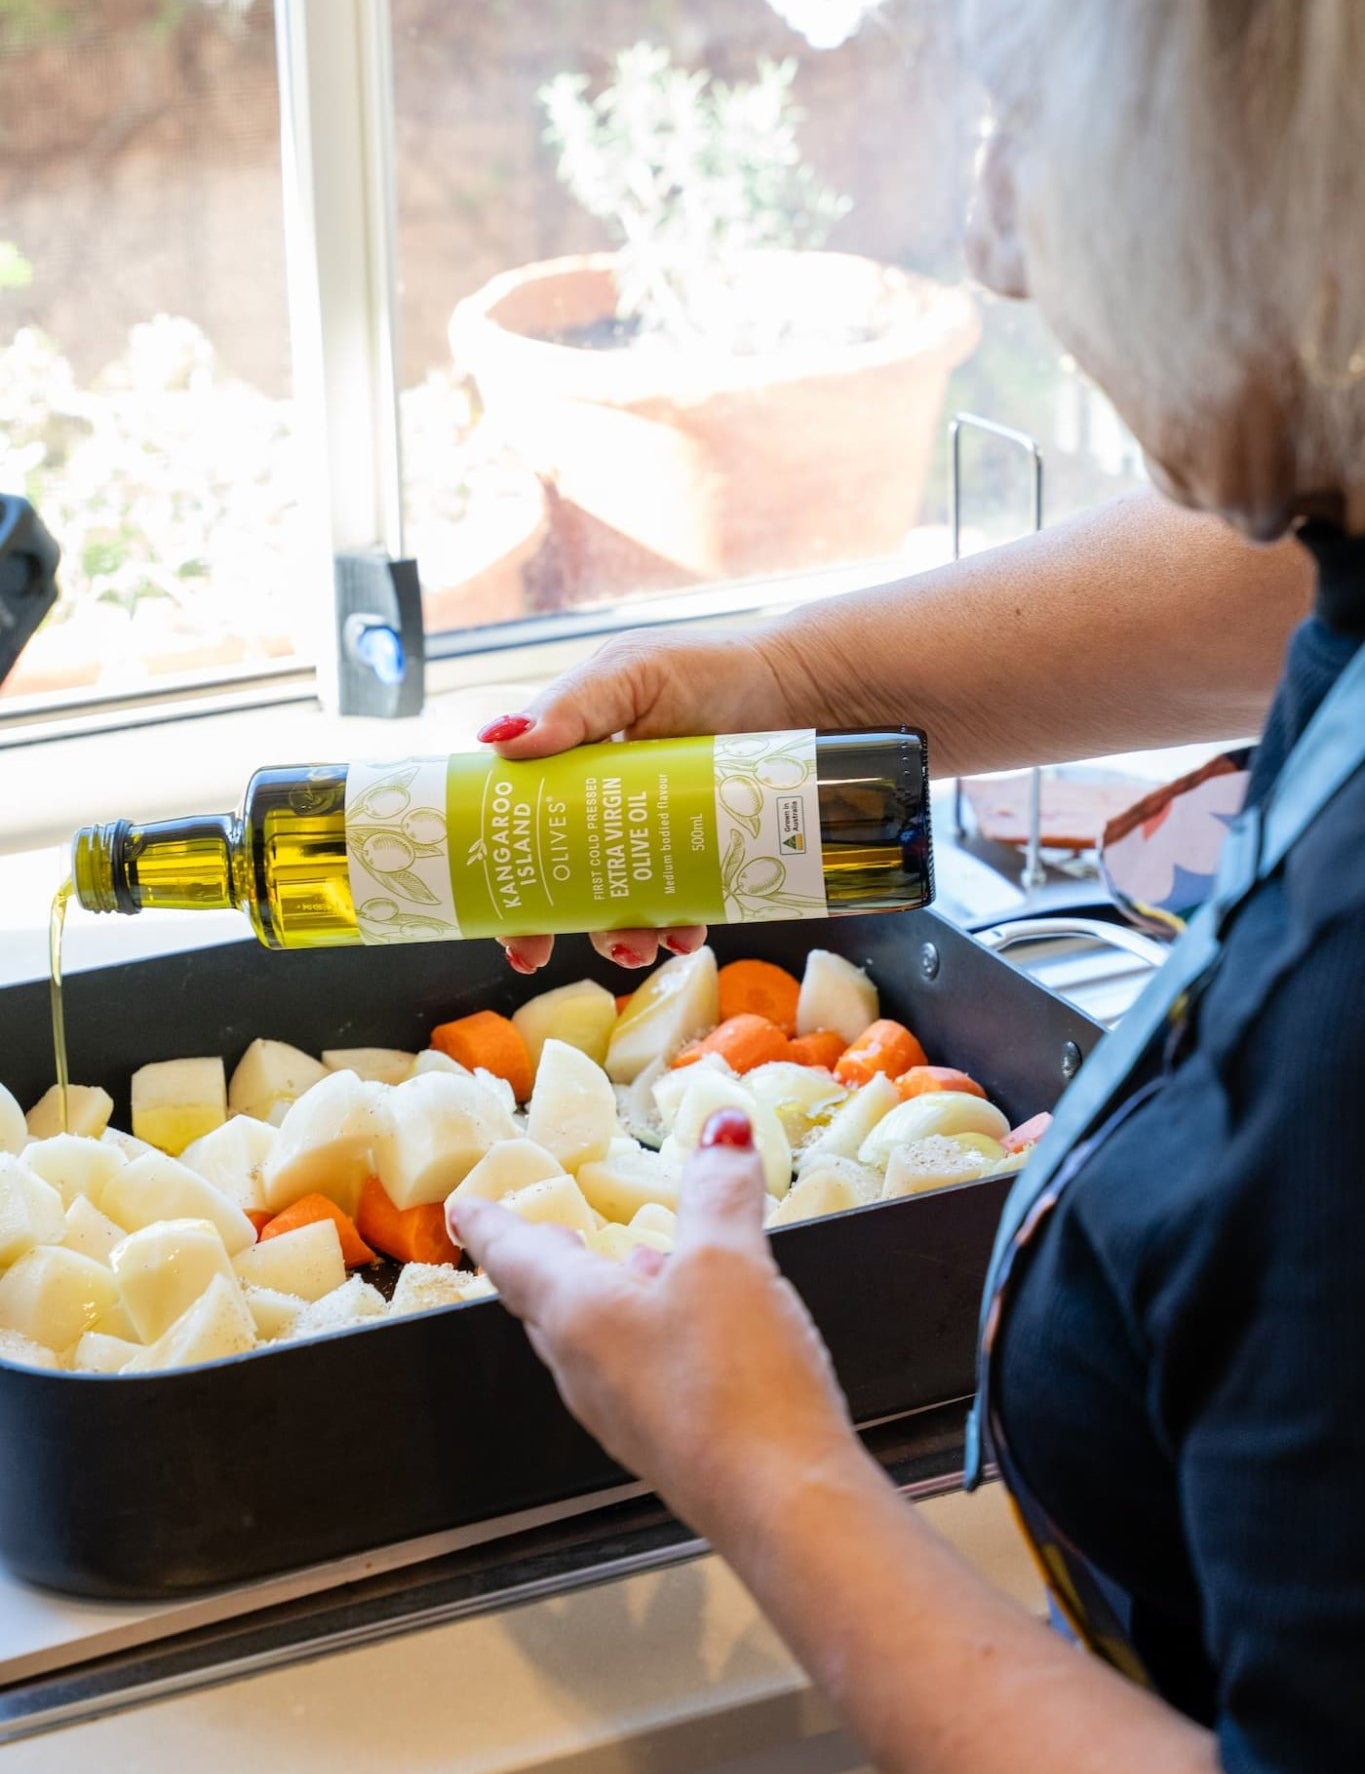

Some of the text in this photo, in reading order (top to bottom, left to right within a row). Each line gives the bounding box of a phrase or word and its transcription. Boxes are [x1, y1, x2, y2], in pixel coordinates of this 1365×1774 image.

[492, 781, 522, 908] KANGAROO
[513, 803, 537, 886] ISLAND
[585, 777, 605, 900] FIRST COLD PRESSED
[602, 777, 629, 898] EXTRA VIRGIN
[627, 791, 653, 881] OLIVE OIL
[656, 773, 676, 895] Medium bodied flavour
[690, 812, 705, 852] 500mL
